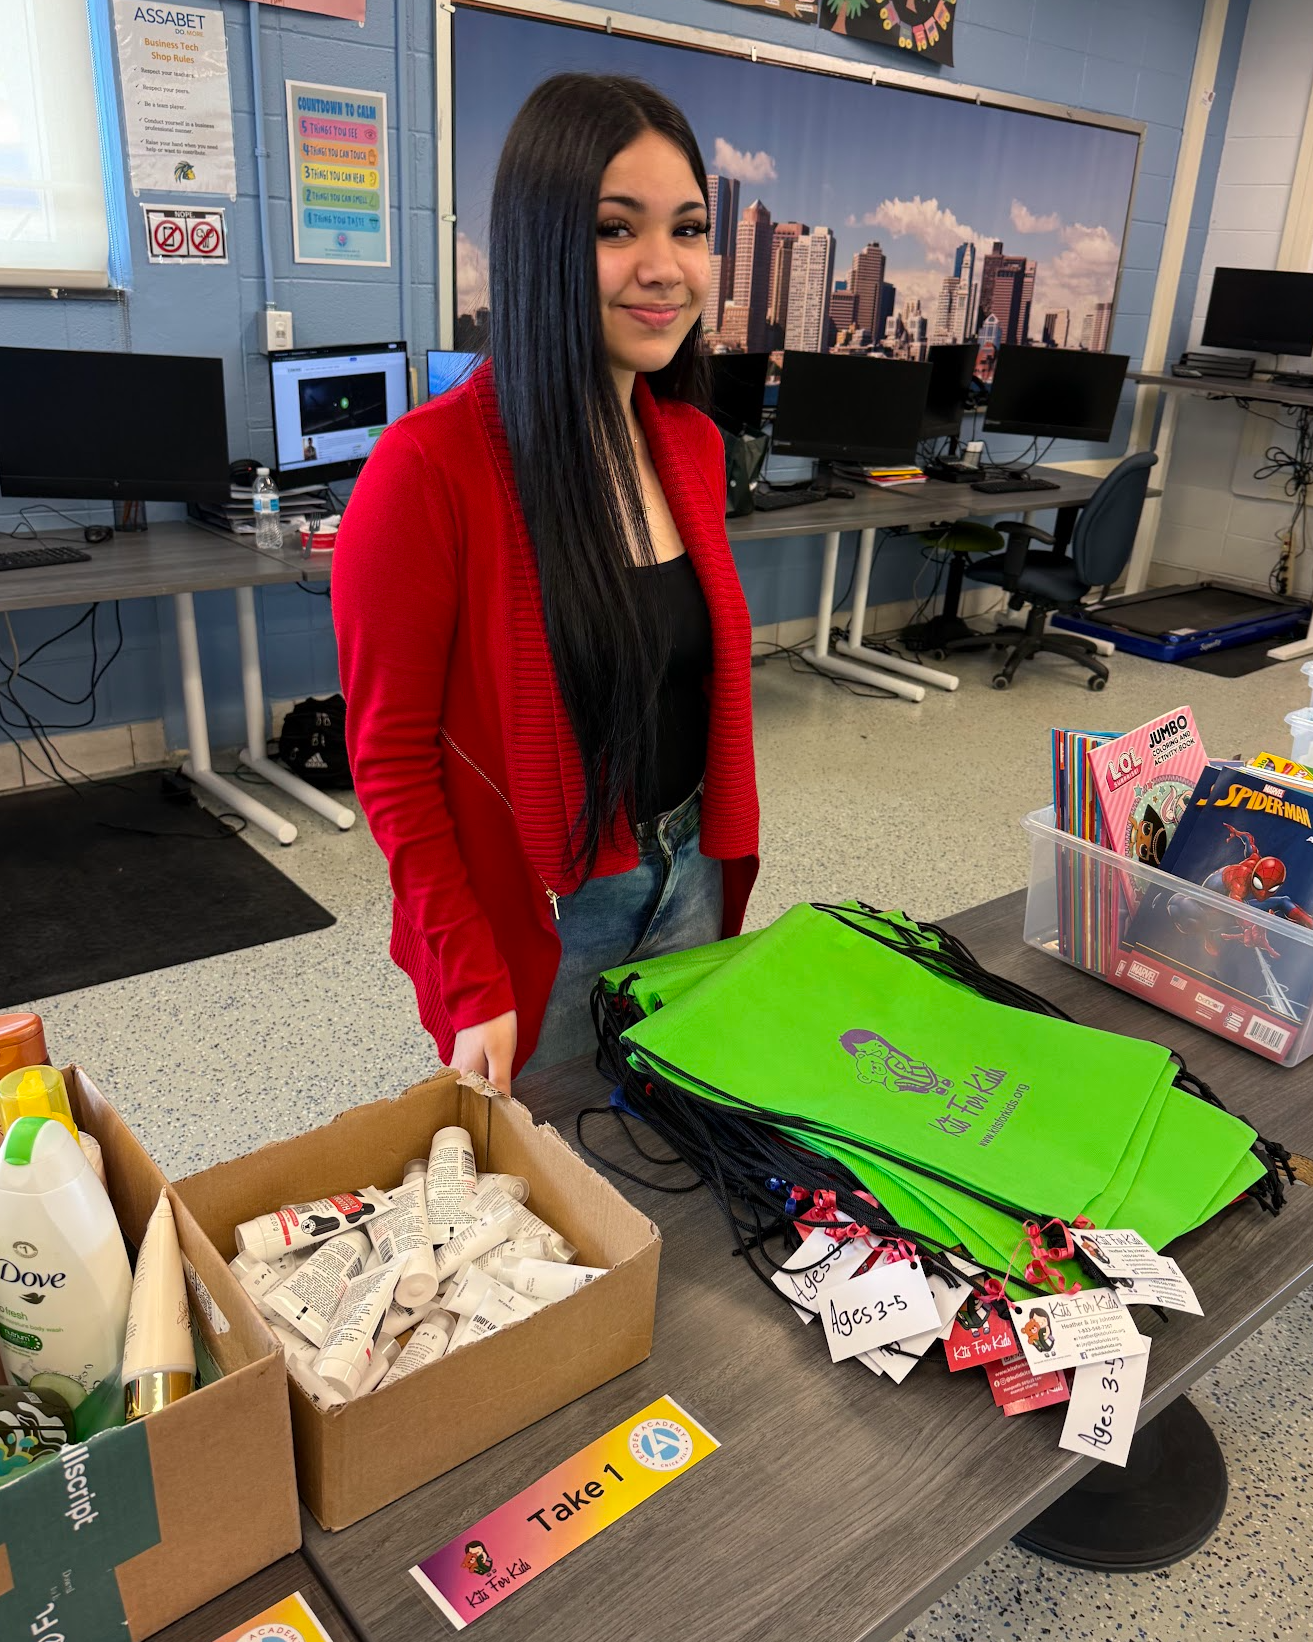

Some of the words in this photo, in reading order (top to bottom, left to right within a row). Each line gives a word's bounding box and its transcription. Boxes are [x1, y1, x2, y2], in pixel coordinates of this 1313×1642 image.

[134, 7, 205, 29] ASSABET
[144, 38, 179, 50] Business
[180, 42, 199, 52] Tech
[152, 52, 172, 62] Shop
[174, 55, 194, 64] Rules
[140, 66, 161, 75] Respect
[298, 96, 342, 116] COUNTDOWN
[345, 102, 354, 117] TO
[357, 104, 376, 120] CALM
[302, 120, 308, 134] 5
[334, 125, 346, 136] YOU
[348, 128, 358, 139] SEE
[302, 143, 309, 156] 4
[328, 148, 338, 158] YOU
[340, 149, 349, 158] CAN
[350, 150, 366, 160] TOUCH
[304, 166, 310, 178] 3
[330, 170, 340, 182] YOU
[342, 172, 351, 182] CAN
[352, 172, 365, 184] HEAR
[306, 189, 312, 202] 2
[330, 193, 340, 202] YOU
[342, 194, 352, 202] CAN
[352, 195, 368, 204] SMELL
[308, 212, 312, 224] 1
[333, 214, 346, 225] YOU
[348, 216, 365, 226] TASTE
[1149, 715, 1188, 748] JUMBO
[1152, 737, 1179, 757] COLORING
[1180, 730, 1191, 741] AND
[1154, 748, 1178, 766] ACTIVITY
[1178, 738, 1196, 752] BOOK
[1264, 784, 1285, 798] MARVEL
[1213, 784, 1312, 829] SPIDER-MAN
[1131, 963, 1156, 982] MARVEL
[963, 1066, 1007, 1096] Kids
[946, 1094, 988, 1116] For
[978, 1084, 1030, 1148] www.kitsforkids.org
[928, 1114, 972, 1138] Kits
[0, 1258, 66, 1288] Dove
[790, 1263, 830, 1304] Ages
[5, 1307, 28, 1321] fresh
[830, 1299, 872, 1336] Ages
[874, 1295, 908, 1320] 3-5
[1048, 1302, 1072, 1318] Kits
[1070, 1298, 1094, 1314] For
[1093, 1292, 1118, 1311] Kids
[30, 1324, 44, 1332] body
[472, 1314, 490, 1327] BODY
[487, 1322, 498, 1330] LO
[1061, 1320, 1083, 1330] Heather
[953, 1346, 972, 1360] Kits
[972, 1340, 992, 1354] For
[992, 1332, 1012, 1350] Kids
[1078, 1404, 1114, 1451] Ages
[1102, 1358, 1124, 1393] 3-5
[632, 1433, 650, 1464] LEADER
[641, 1421, 686, 1437] ACADEMY
[526, 1481, 604, 1532] Take
[604, 1463, 624, 1482] 1
[466, 1588, 490, 1608] Kits
[485, 1575, 510, 1592] For
[506, 1558, 532, 1580] Kids
[249, 1627, 301, 1642] ACADEM
